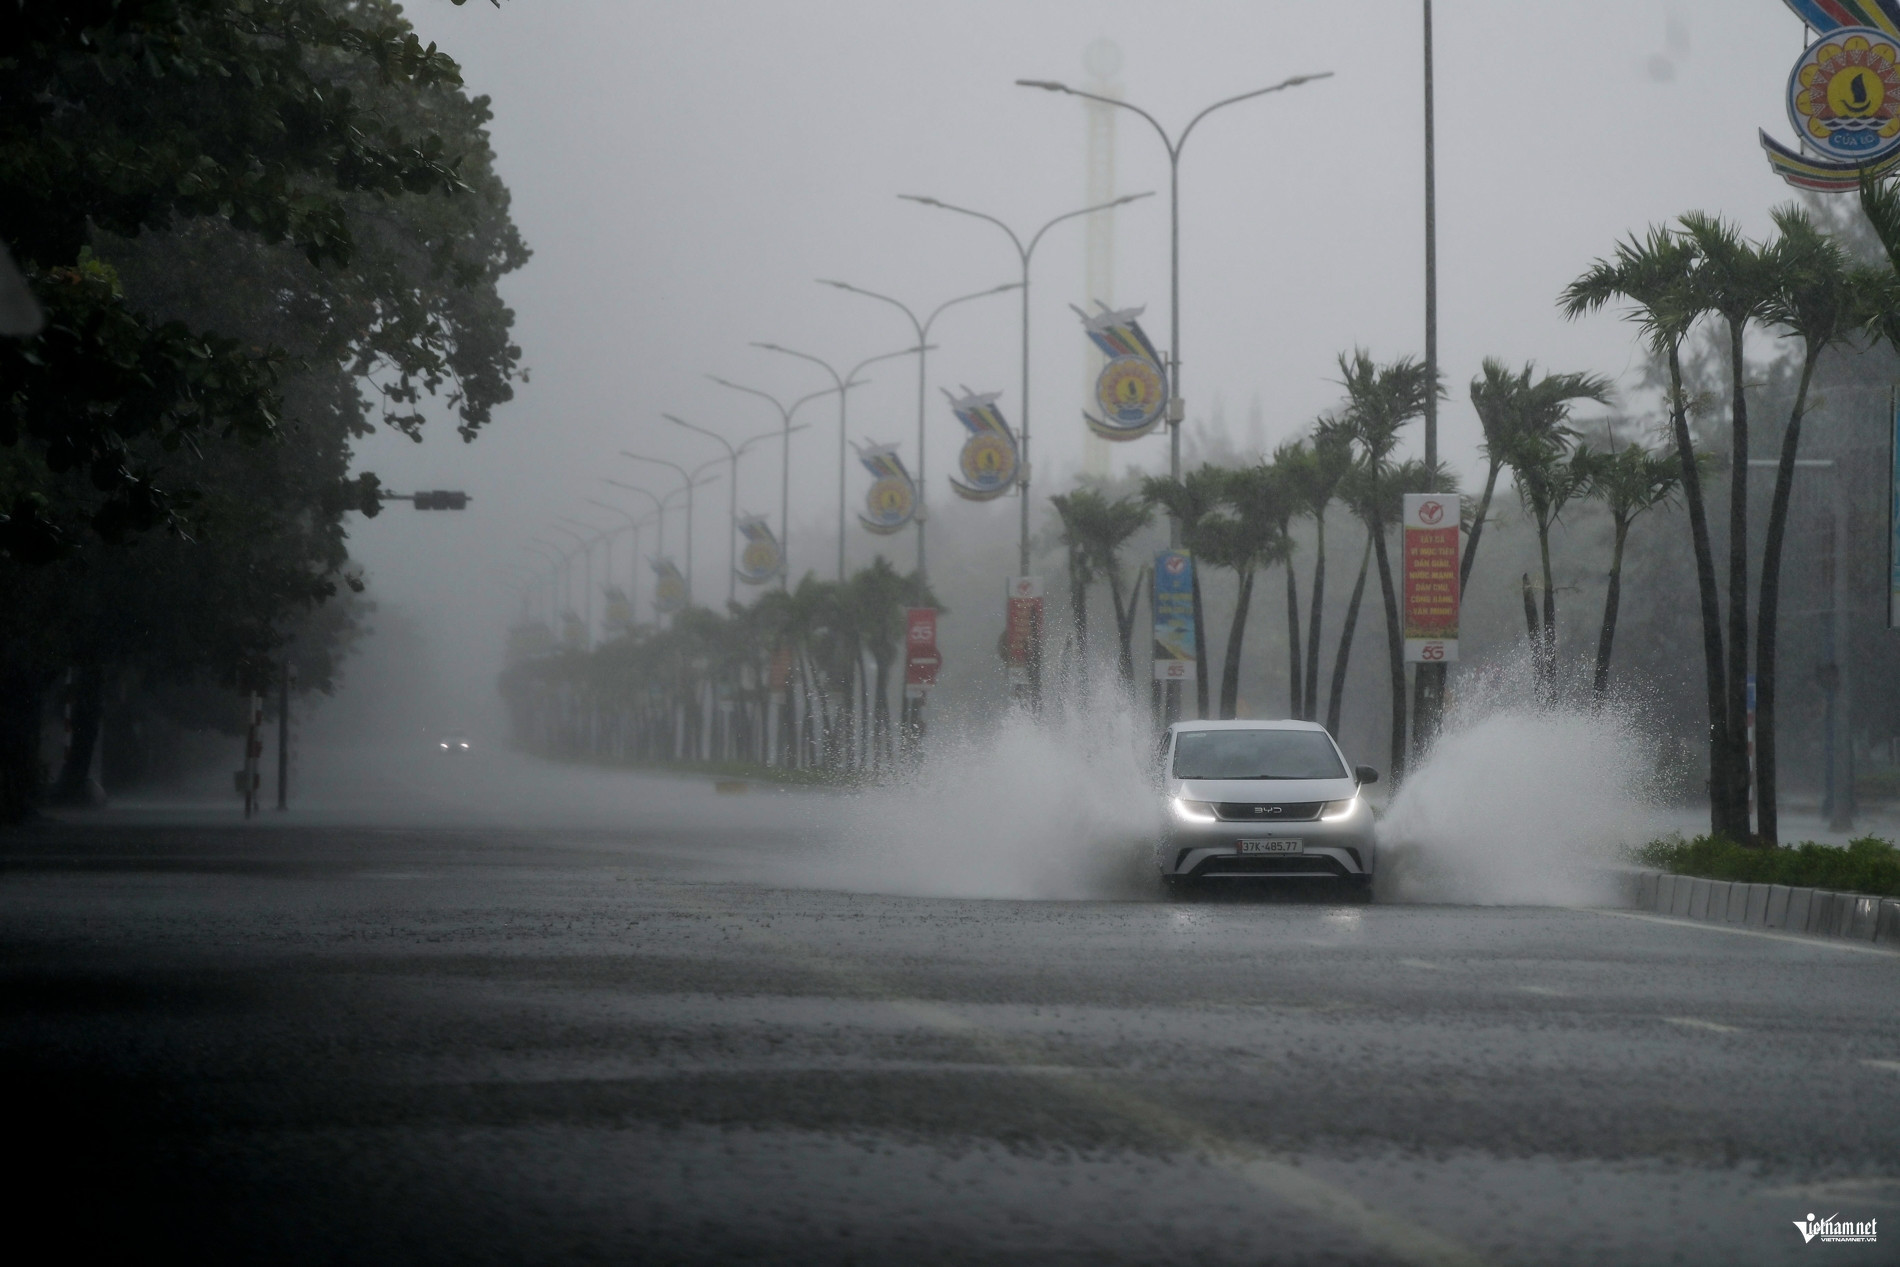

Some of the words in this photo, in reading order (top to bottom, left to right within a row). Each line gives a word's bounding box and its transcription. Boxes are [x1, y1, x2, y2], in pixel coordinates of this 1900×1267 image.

[1422, 645, 1444, 660] 5G
[1254, 806, 1282, 814] BYD
[1243, 841, 1297, 851] 37K-485.77
